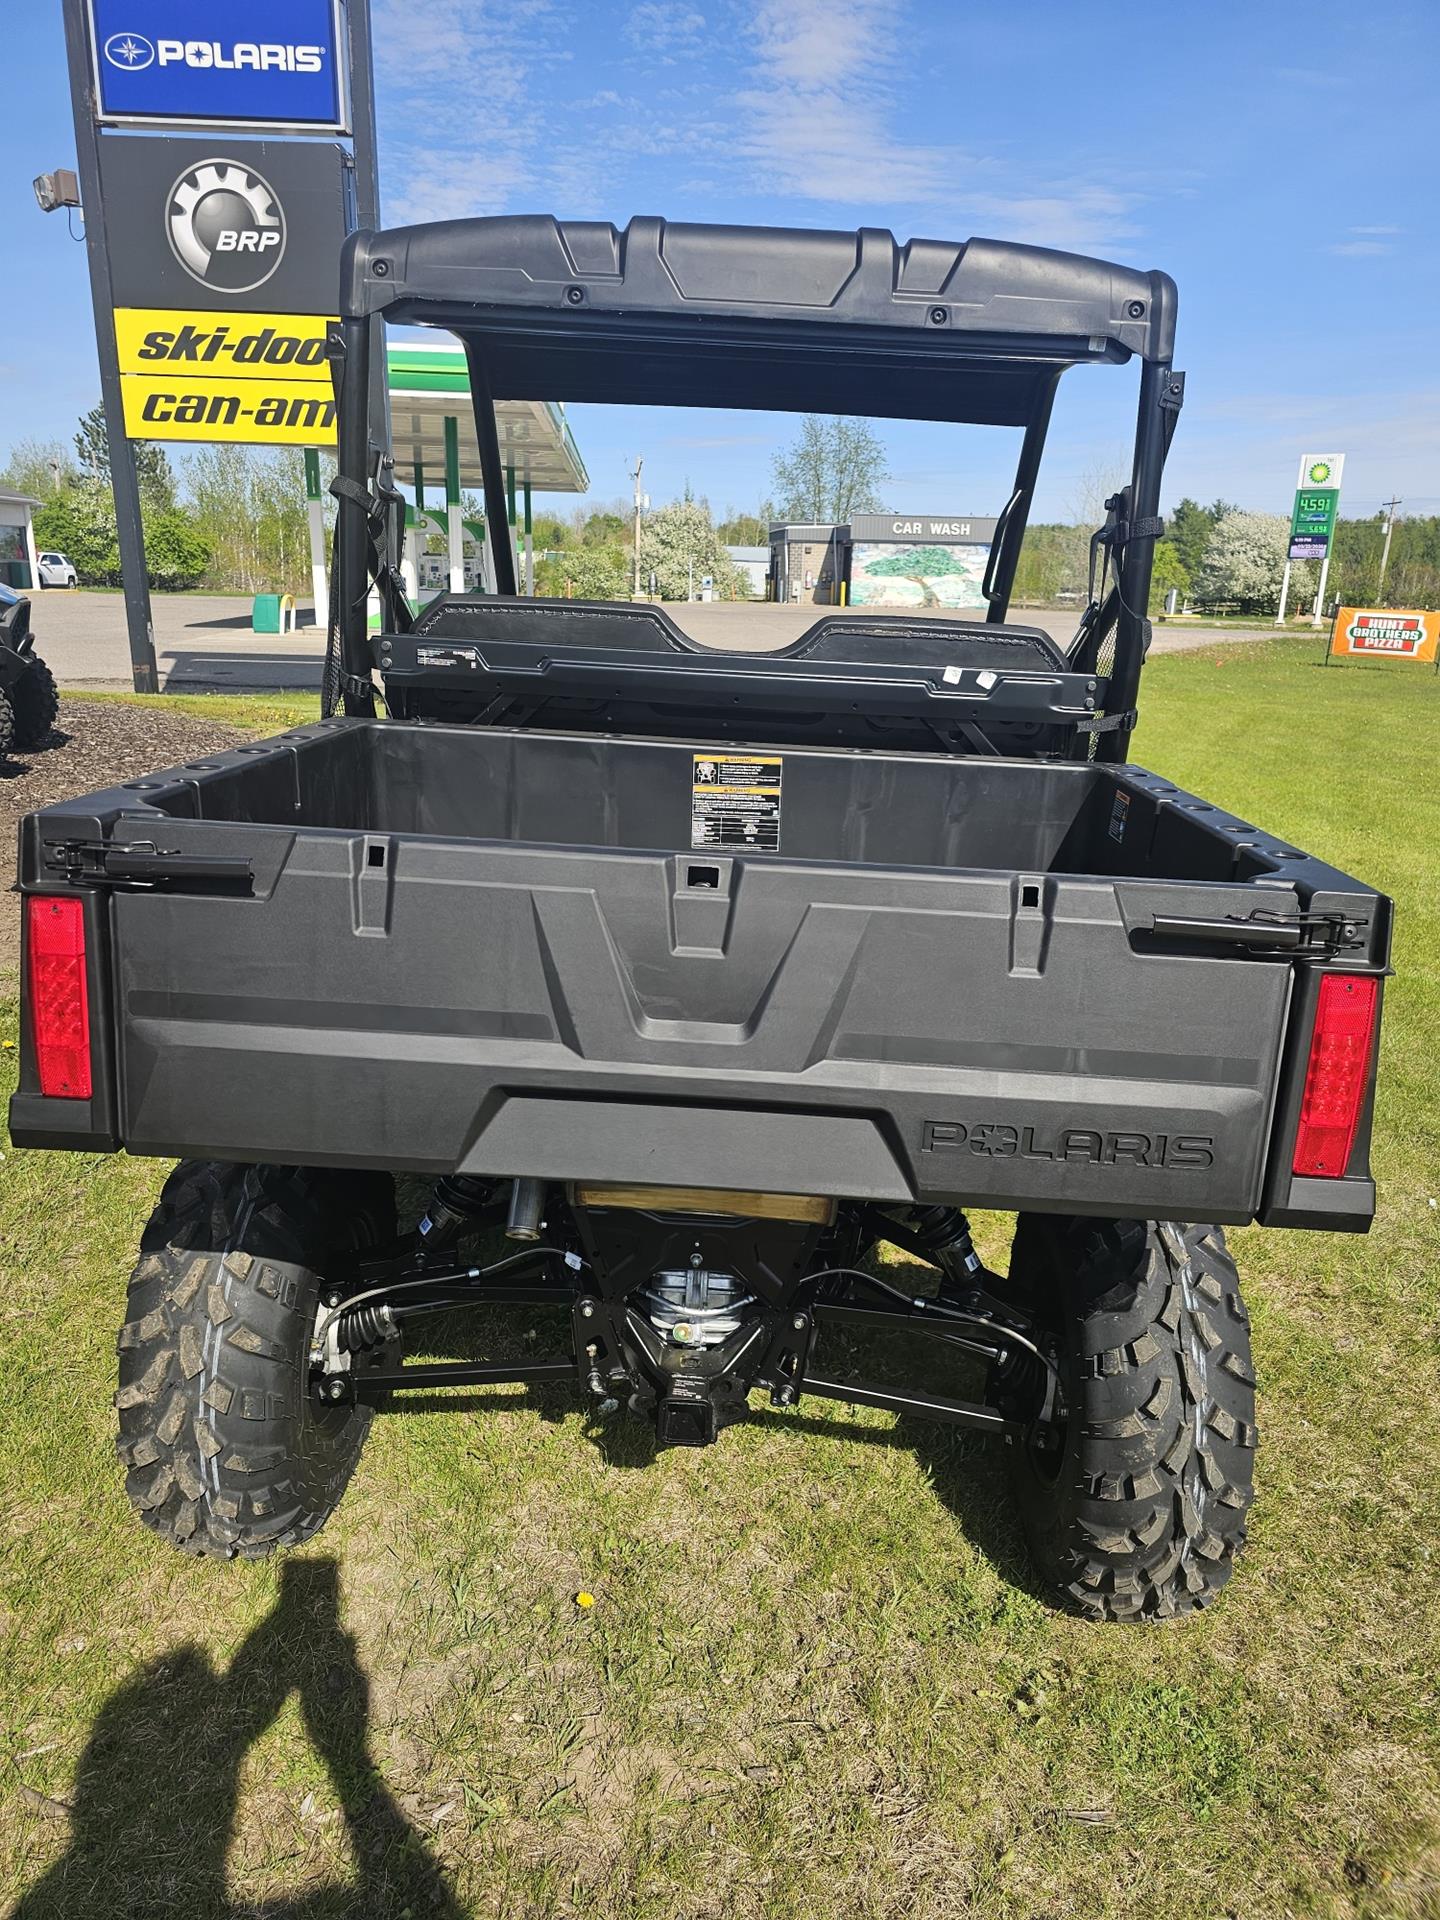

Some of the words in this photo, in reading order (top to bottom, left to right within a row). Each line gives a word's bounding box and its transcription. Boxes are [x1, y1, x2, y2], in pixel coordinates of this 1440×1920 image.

[157, 39, 322, 73] POLARIS
[215, 230, 281, 252] BRP
[138, 325, 327, 366] ski-doo
[141, 393, 337, 428] can-am
[892, 521, 922, 535] CAR
[930, 522, 970, 536] WASH
[1352, 627, 1420, 640] BROTHERS
[1368, 618, 1407, 630] HUNT
[1364, 637, 1403, 649] PIZZA
[920, 1119, 1215, 1171] POLARIS
